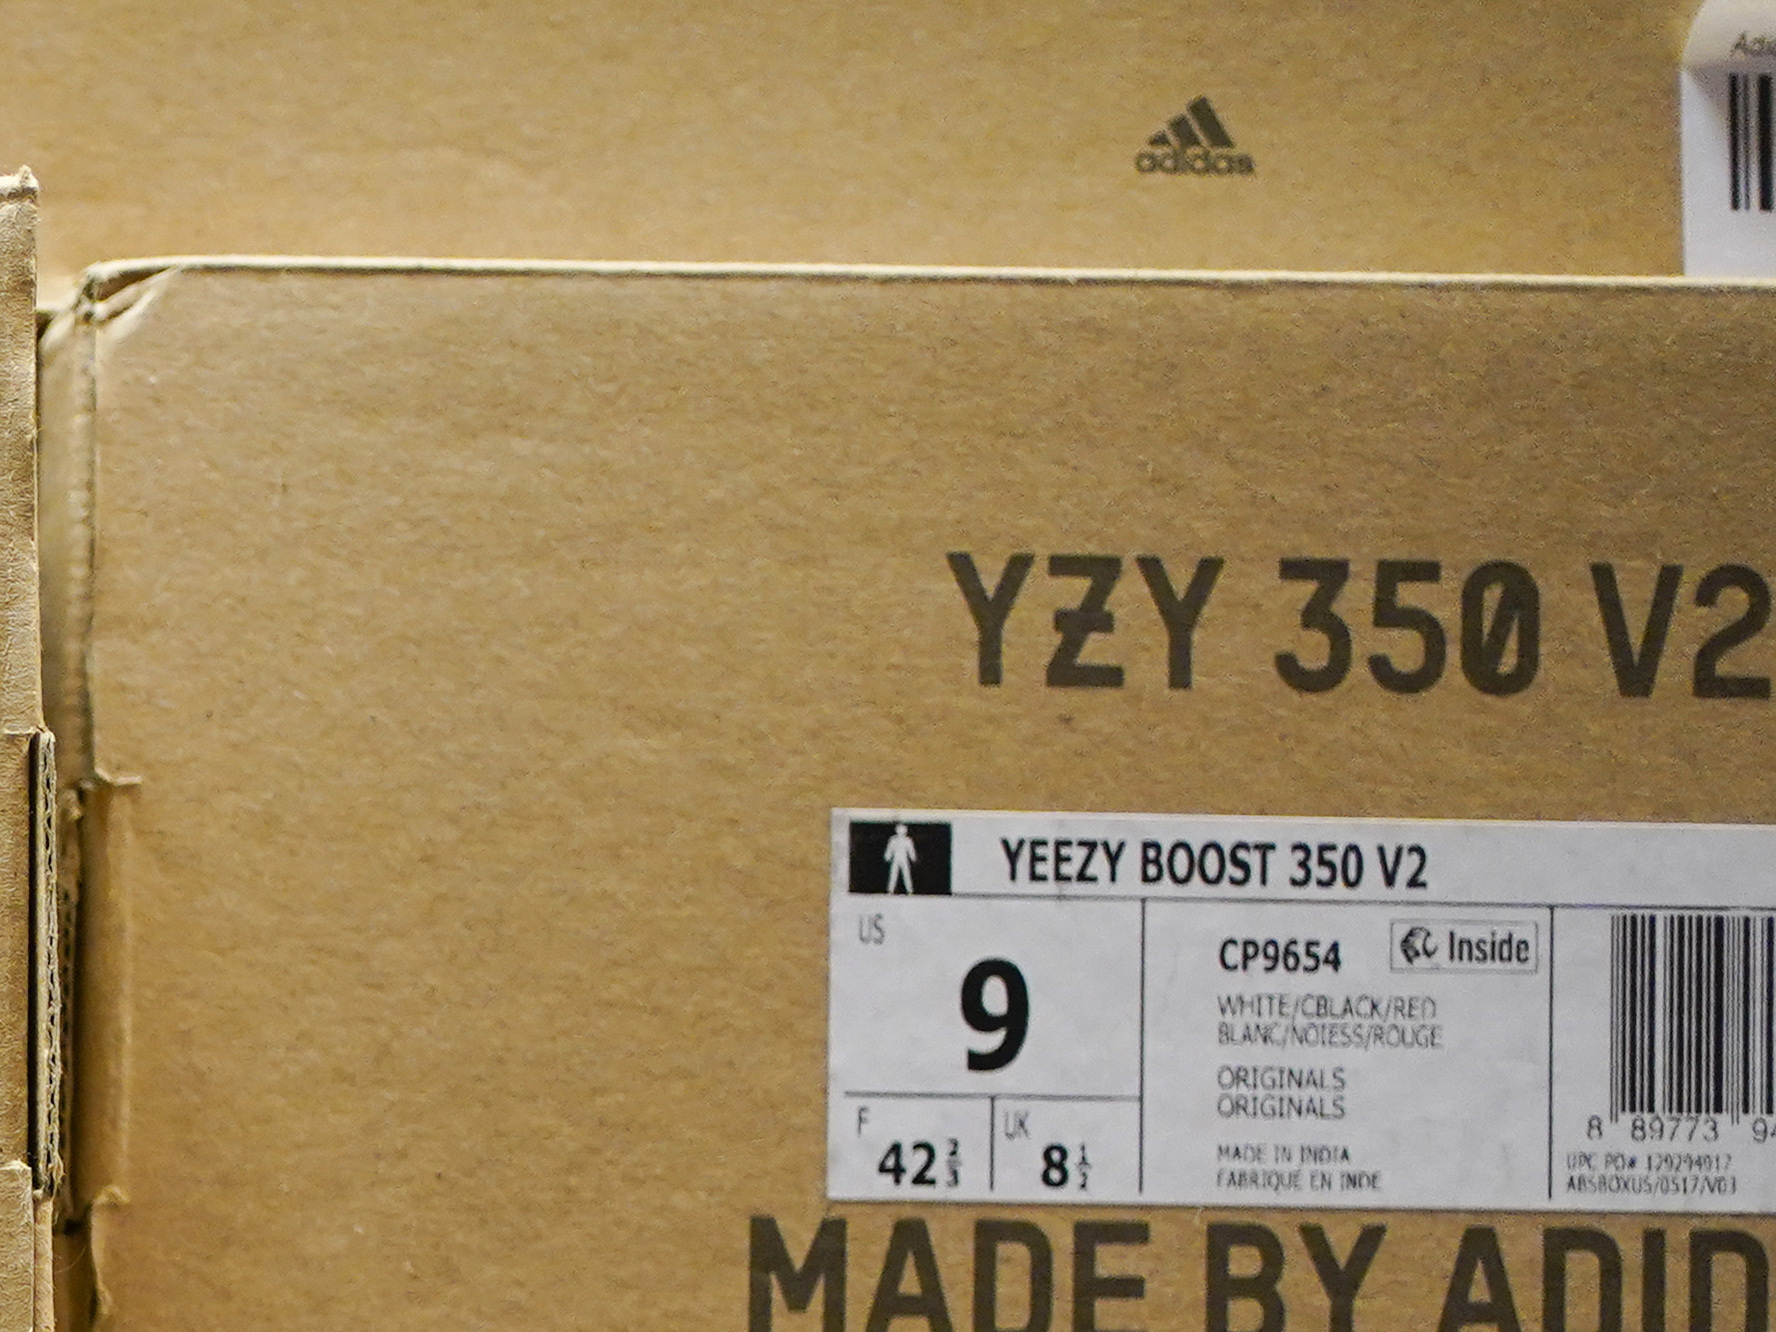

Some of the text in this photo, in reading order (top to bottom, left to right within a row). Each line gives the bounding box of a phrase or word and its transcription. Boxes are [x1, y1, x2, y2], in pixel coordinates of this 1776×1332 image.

[1136, 144, 1254, 175] adidas
[947, 553, 1771, 701] YZY 350 V2
[1002, 839, 1427, 888] YEEZY BOOST 350 V2
[859, 913, 885, 944] US
[1220, 931, 1529, 972] CP9654 Inside
[961, 959, 1029, 1072] 9
[1218, 1066, 1345, 1090] ORIGINALS
[1217, 1095, 1345, 1119] ORIGINALS
[1005, 1113, 1028, 1139] UK
[1631, 1114, 1719, 1141] 89773
